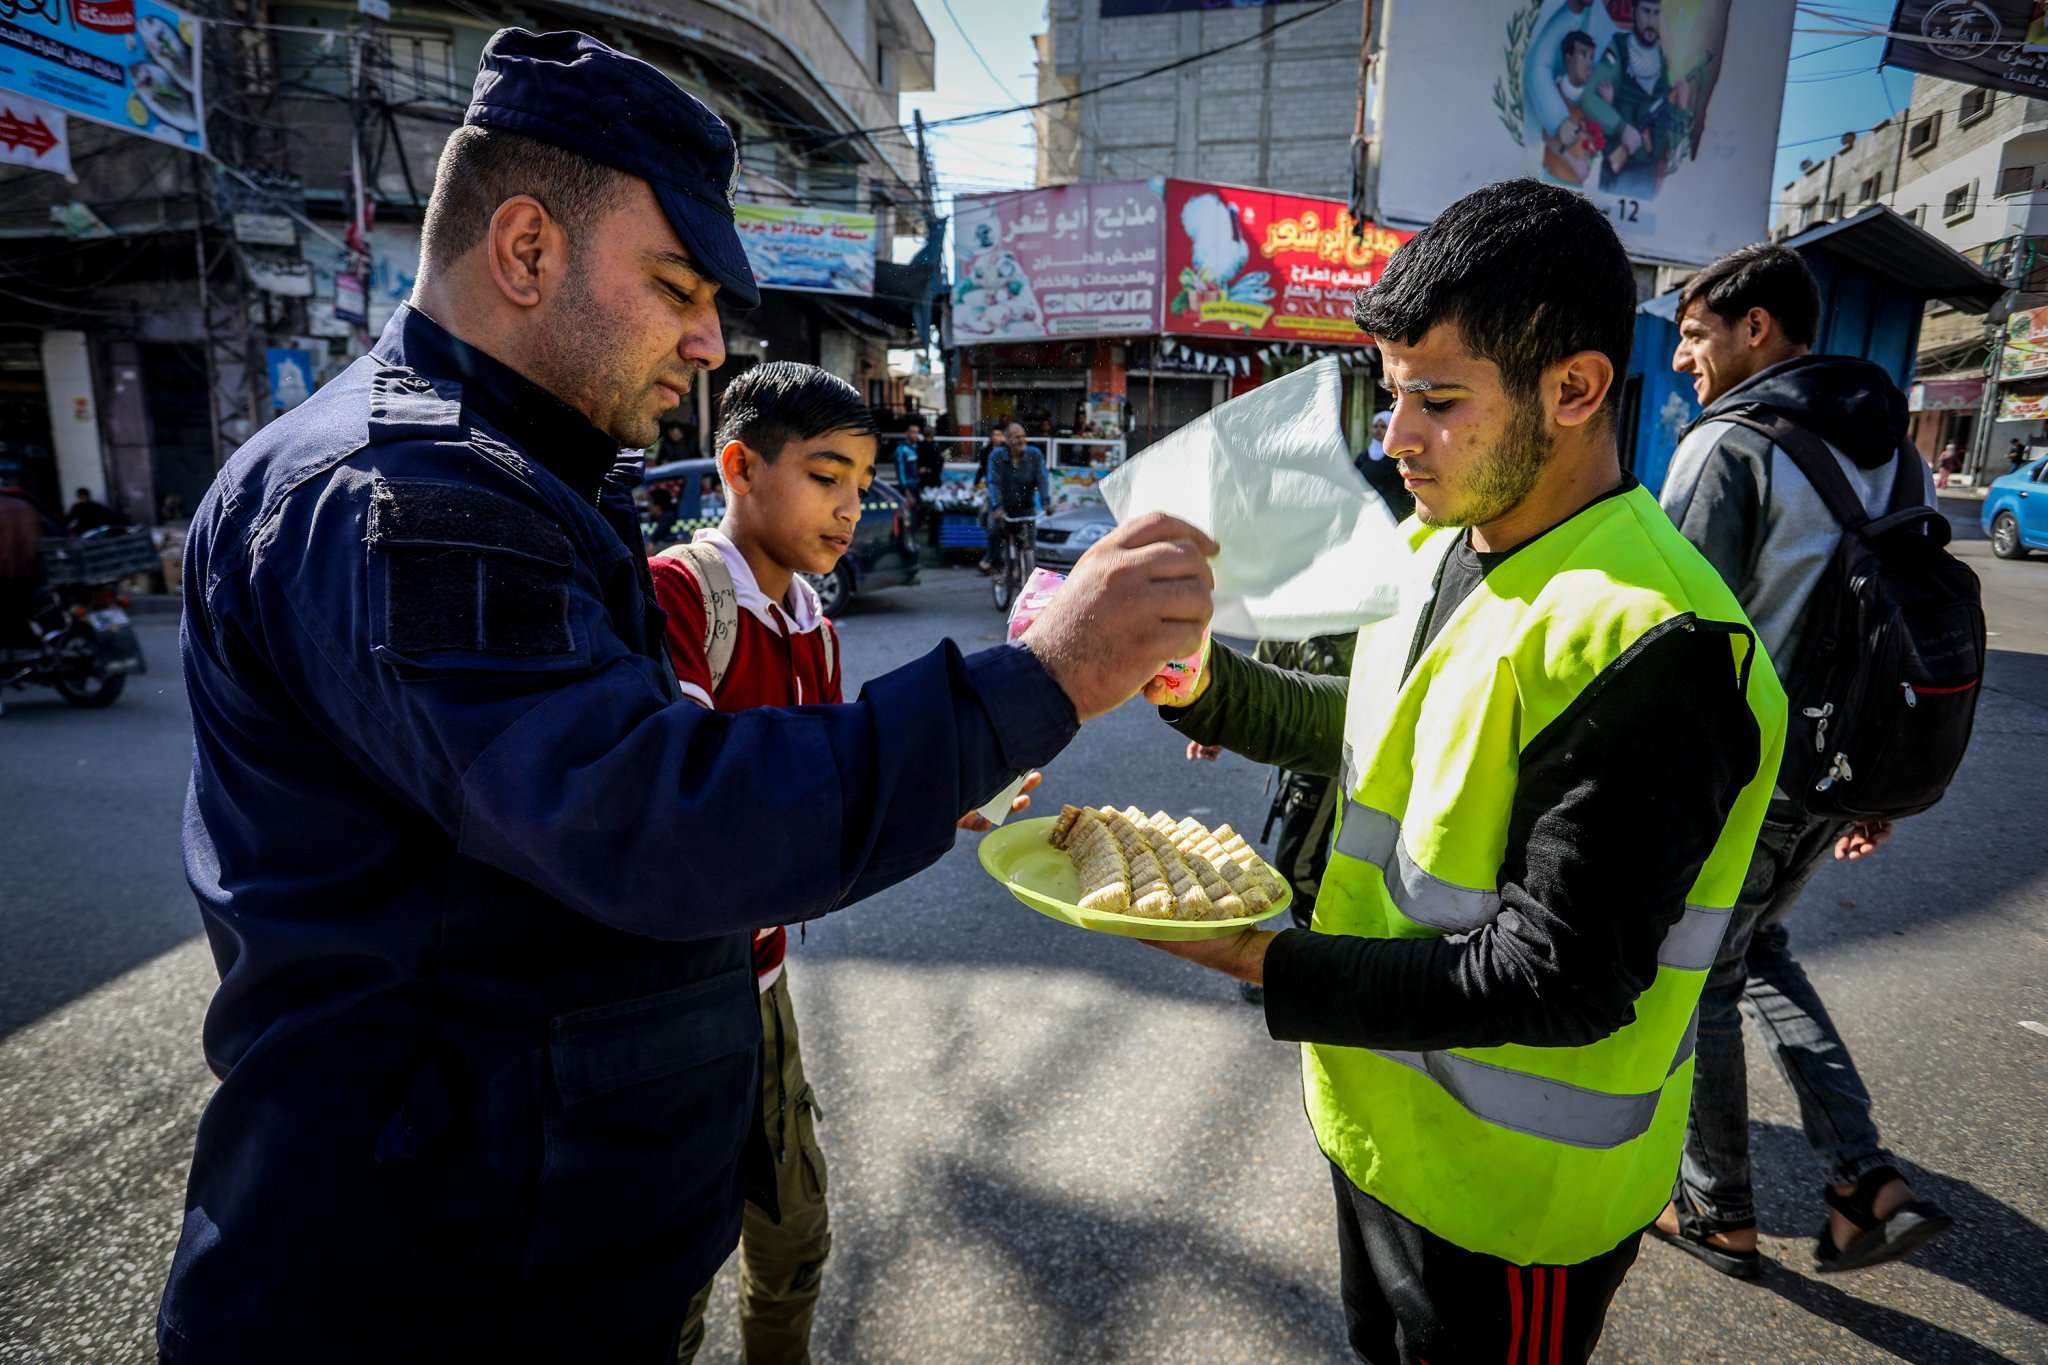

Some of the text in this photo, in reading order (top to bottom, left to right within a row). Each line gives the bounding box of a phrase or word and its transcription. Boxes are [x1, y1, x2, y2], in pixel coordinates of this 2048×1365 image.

[1002, 197, 1157, 242] مذبح أبو شعر
[1617, 198, 1639, 223] 12
[1261, 211, 1320, 258] شعر
[1317, 208, 1354, 263] أبو
